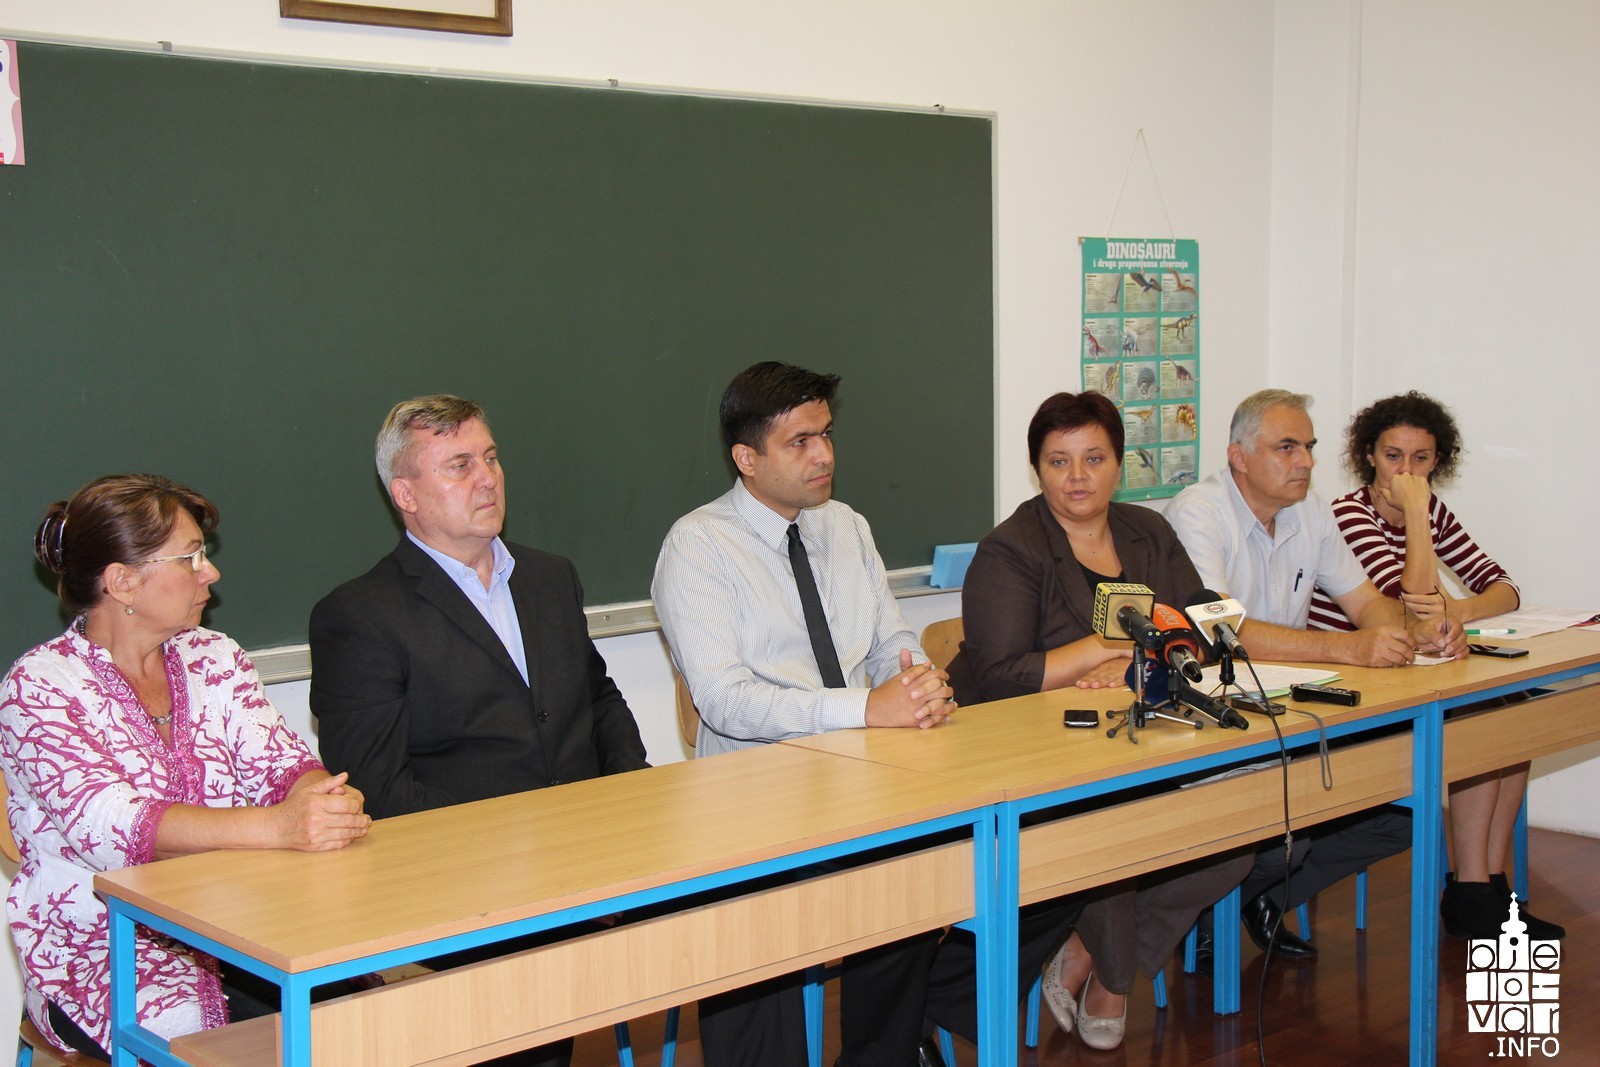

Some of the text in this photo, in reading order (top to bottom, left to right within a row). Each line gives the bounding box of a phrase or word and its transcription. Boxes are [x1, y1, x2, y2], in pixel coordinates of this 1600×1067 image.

[1097, 258, 1117, 270] druga
[1106, 242, 1176, 259] DINOSAURI
[1093, 586, 1103, 631] SUPER
[1099, 593, 1107, 634] RADIO
